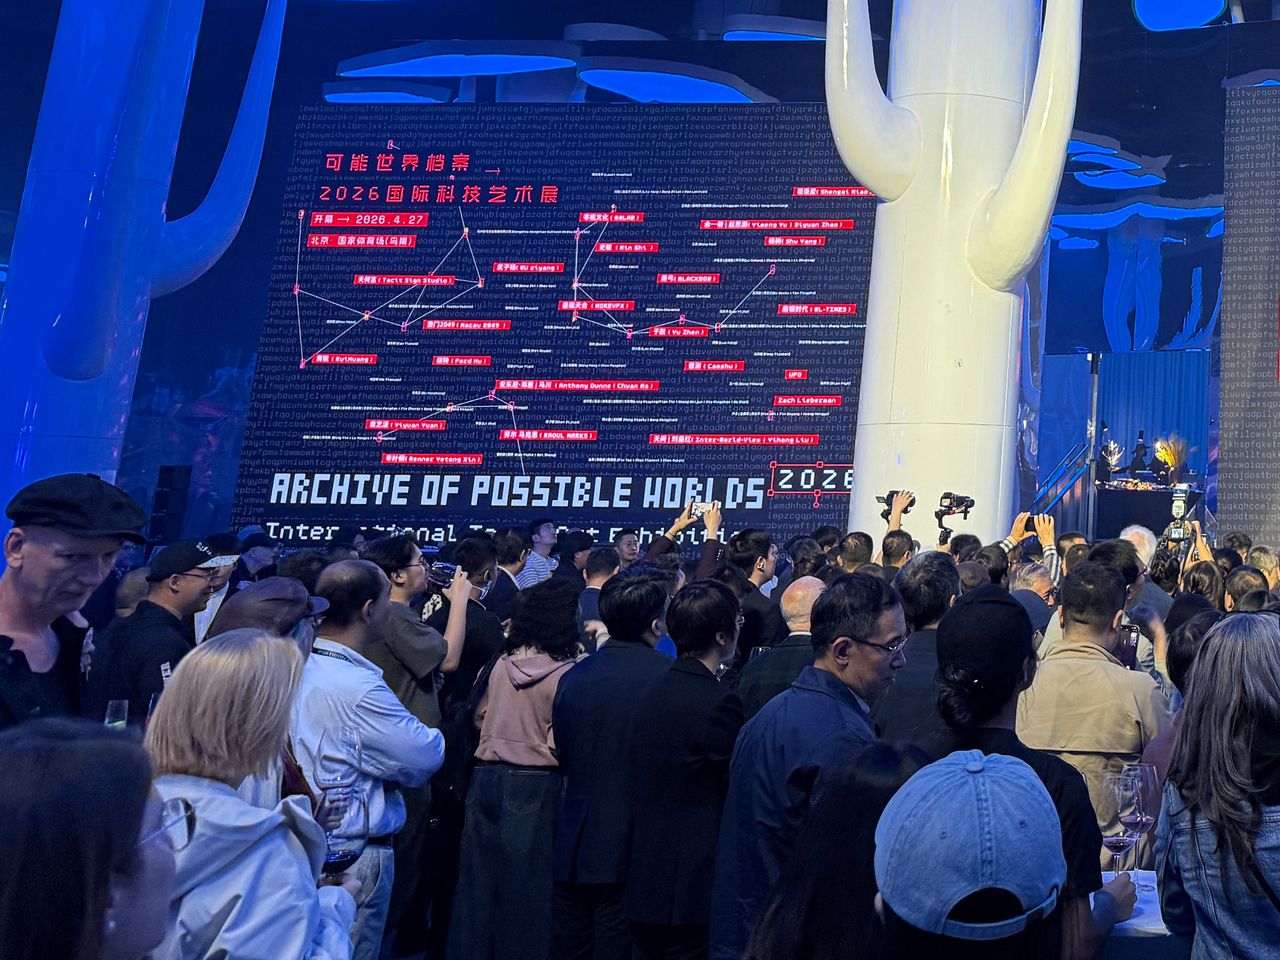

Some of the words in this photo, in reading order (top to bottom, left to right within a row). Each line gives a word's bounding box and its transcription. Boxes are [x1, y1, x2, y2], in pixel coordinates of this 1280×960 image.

[325, 153, 471, 172] 可能世界档案
[319, 185, 560, 204] 2026国际科技艺术展
[356, 214, 424, 225] 2026.4.27
[270, 473, 411, 505] ARCHIVE
[420, 474, 461, 506] OF
[471, 474, 634, 508] POSSIBLE
